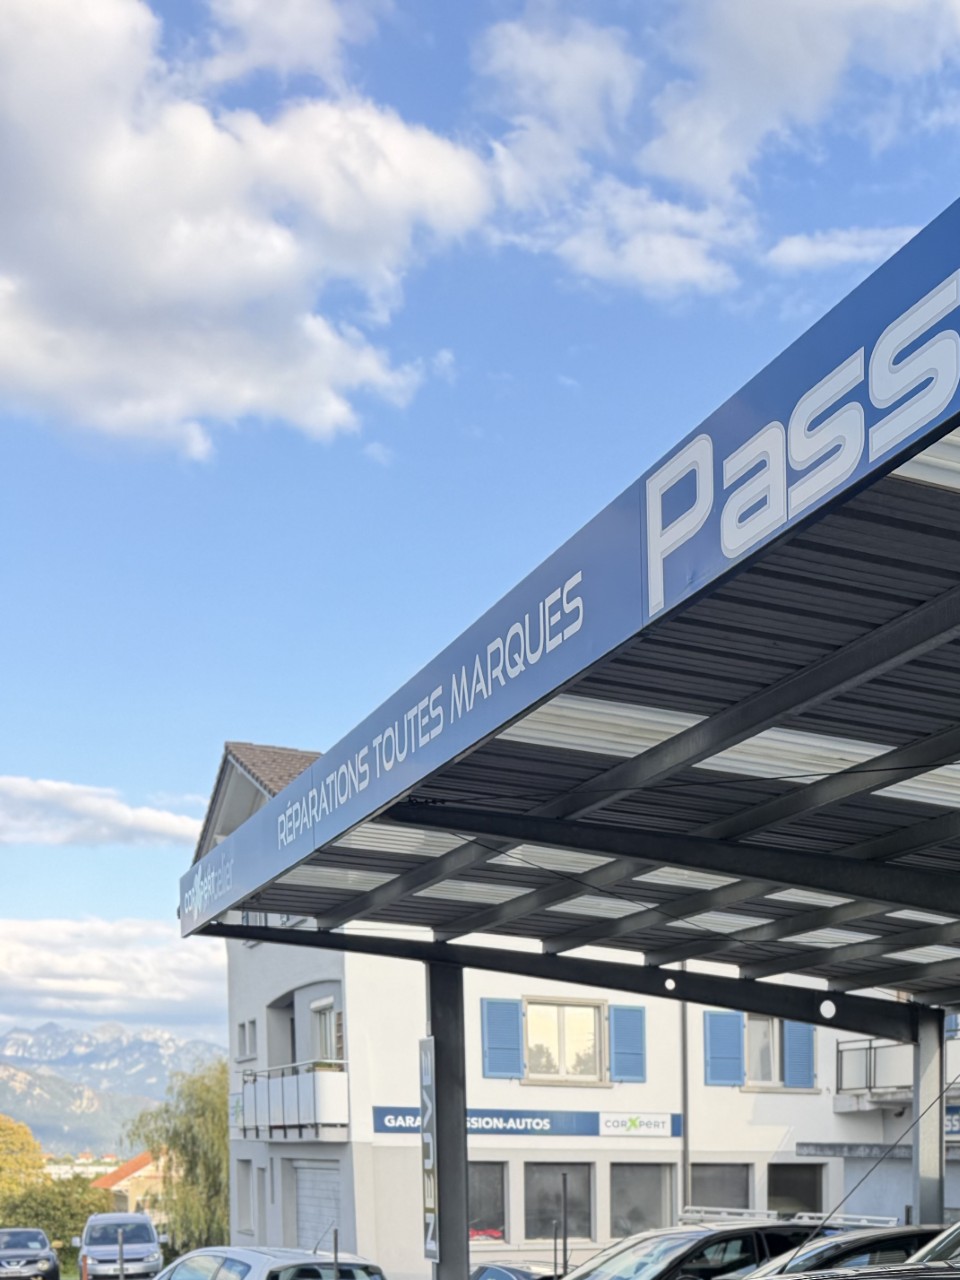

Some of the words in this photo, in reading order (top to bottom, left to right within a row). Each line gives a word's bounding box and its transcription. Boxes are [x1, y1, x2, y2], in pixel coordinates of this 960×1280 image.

[277, 745, 370, 851] RÉPARATIONS
[372, 685, 444, 778] TOUTES
[450, 571, 584, 725] MARQUES
[384, 1115, 421, 1128] GARA
[466, 1116, 551, 1131] SSION-AUTOS
[423, 1050, 437, 1250] NEUVE
